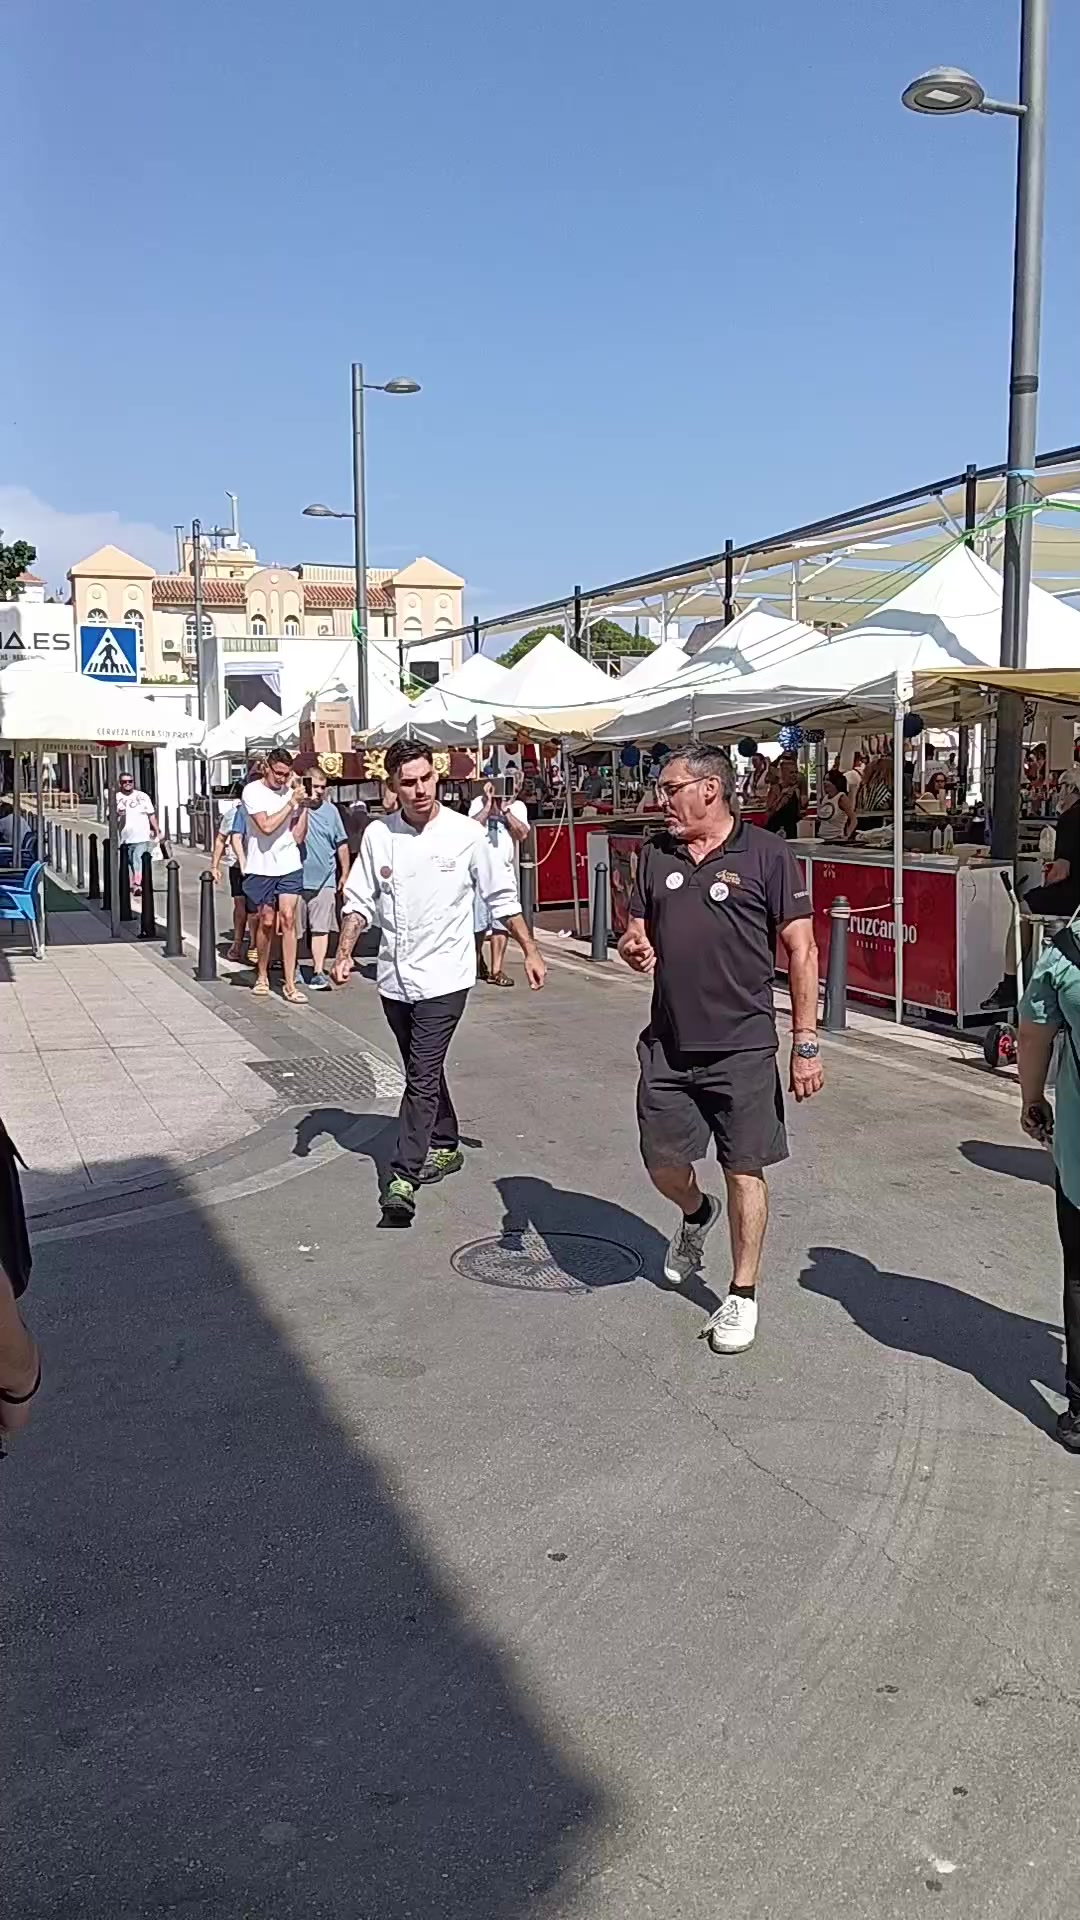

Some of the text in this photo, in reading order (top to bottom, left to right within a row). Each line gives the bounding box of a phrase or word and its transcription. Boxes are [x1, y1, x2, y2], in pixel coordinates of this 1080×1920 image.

[0, 631, 70, 650] A.ES
[96, 727, 129, 736] CERVEZA
[847, 915, 918, 944] ruzcapo
